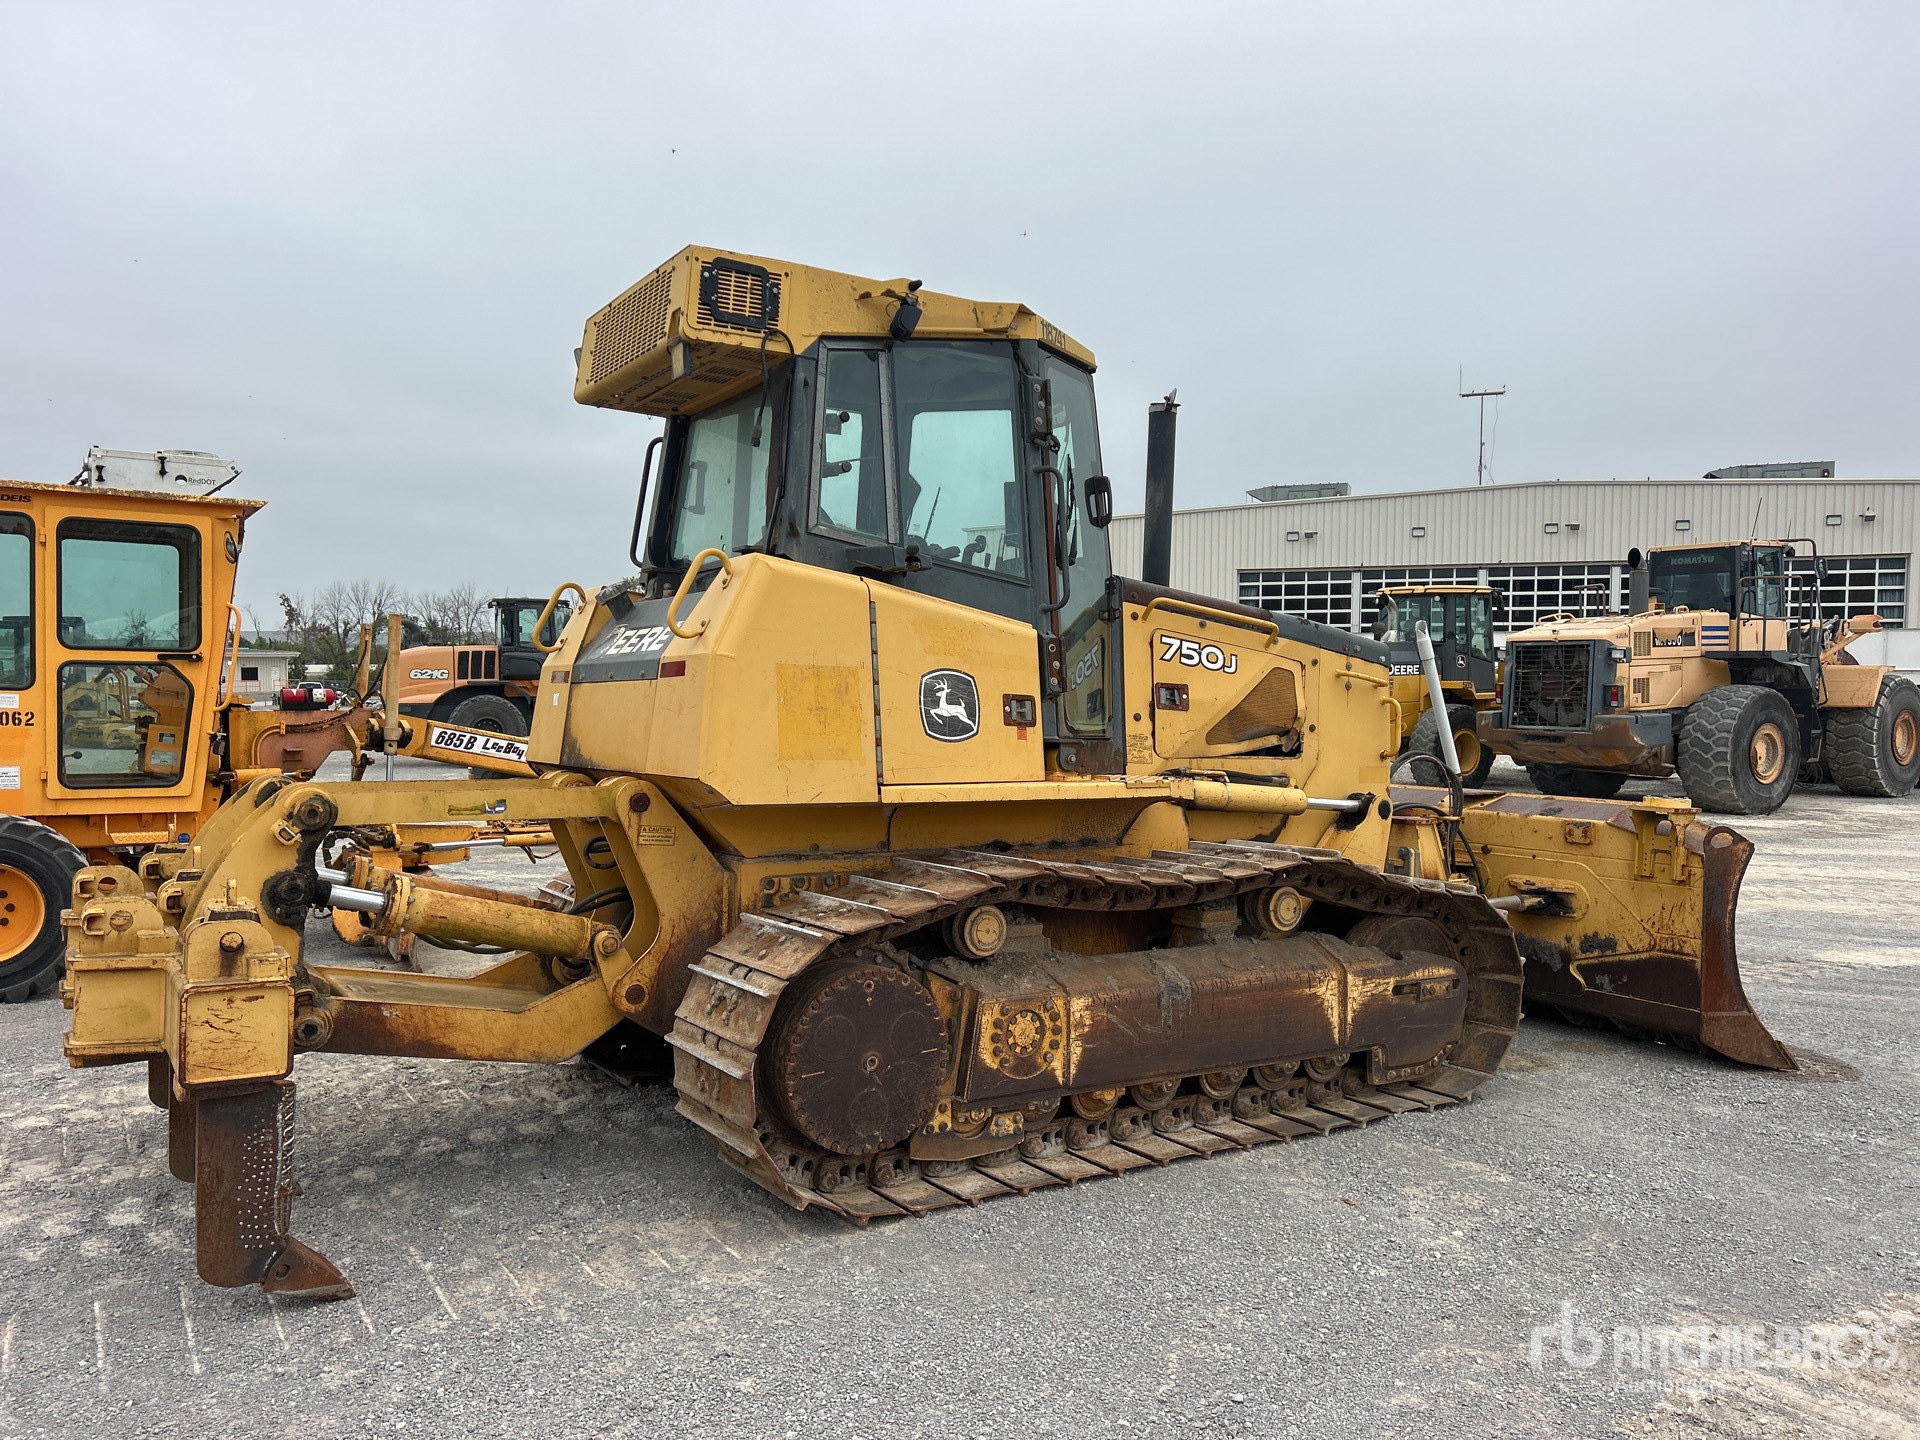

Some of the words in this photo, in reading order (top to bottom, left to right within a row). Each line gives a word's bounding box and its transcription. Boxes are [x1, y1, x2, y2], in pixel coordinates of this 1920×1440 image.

[188, 477, 216, 486] RedDOT
[1670, 555, 1715, 566] KOMATSU
[1159, 634, 1238, 675] 750J
[409, 668, 449, 679] 621G
[481, 738, 525, 760] LeeBoy
